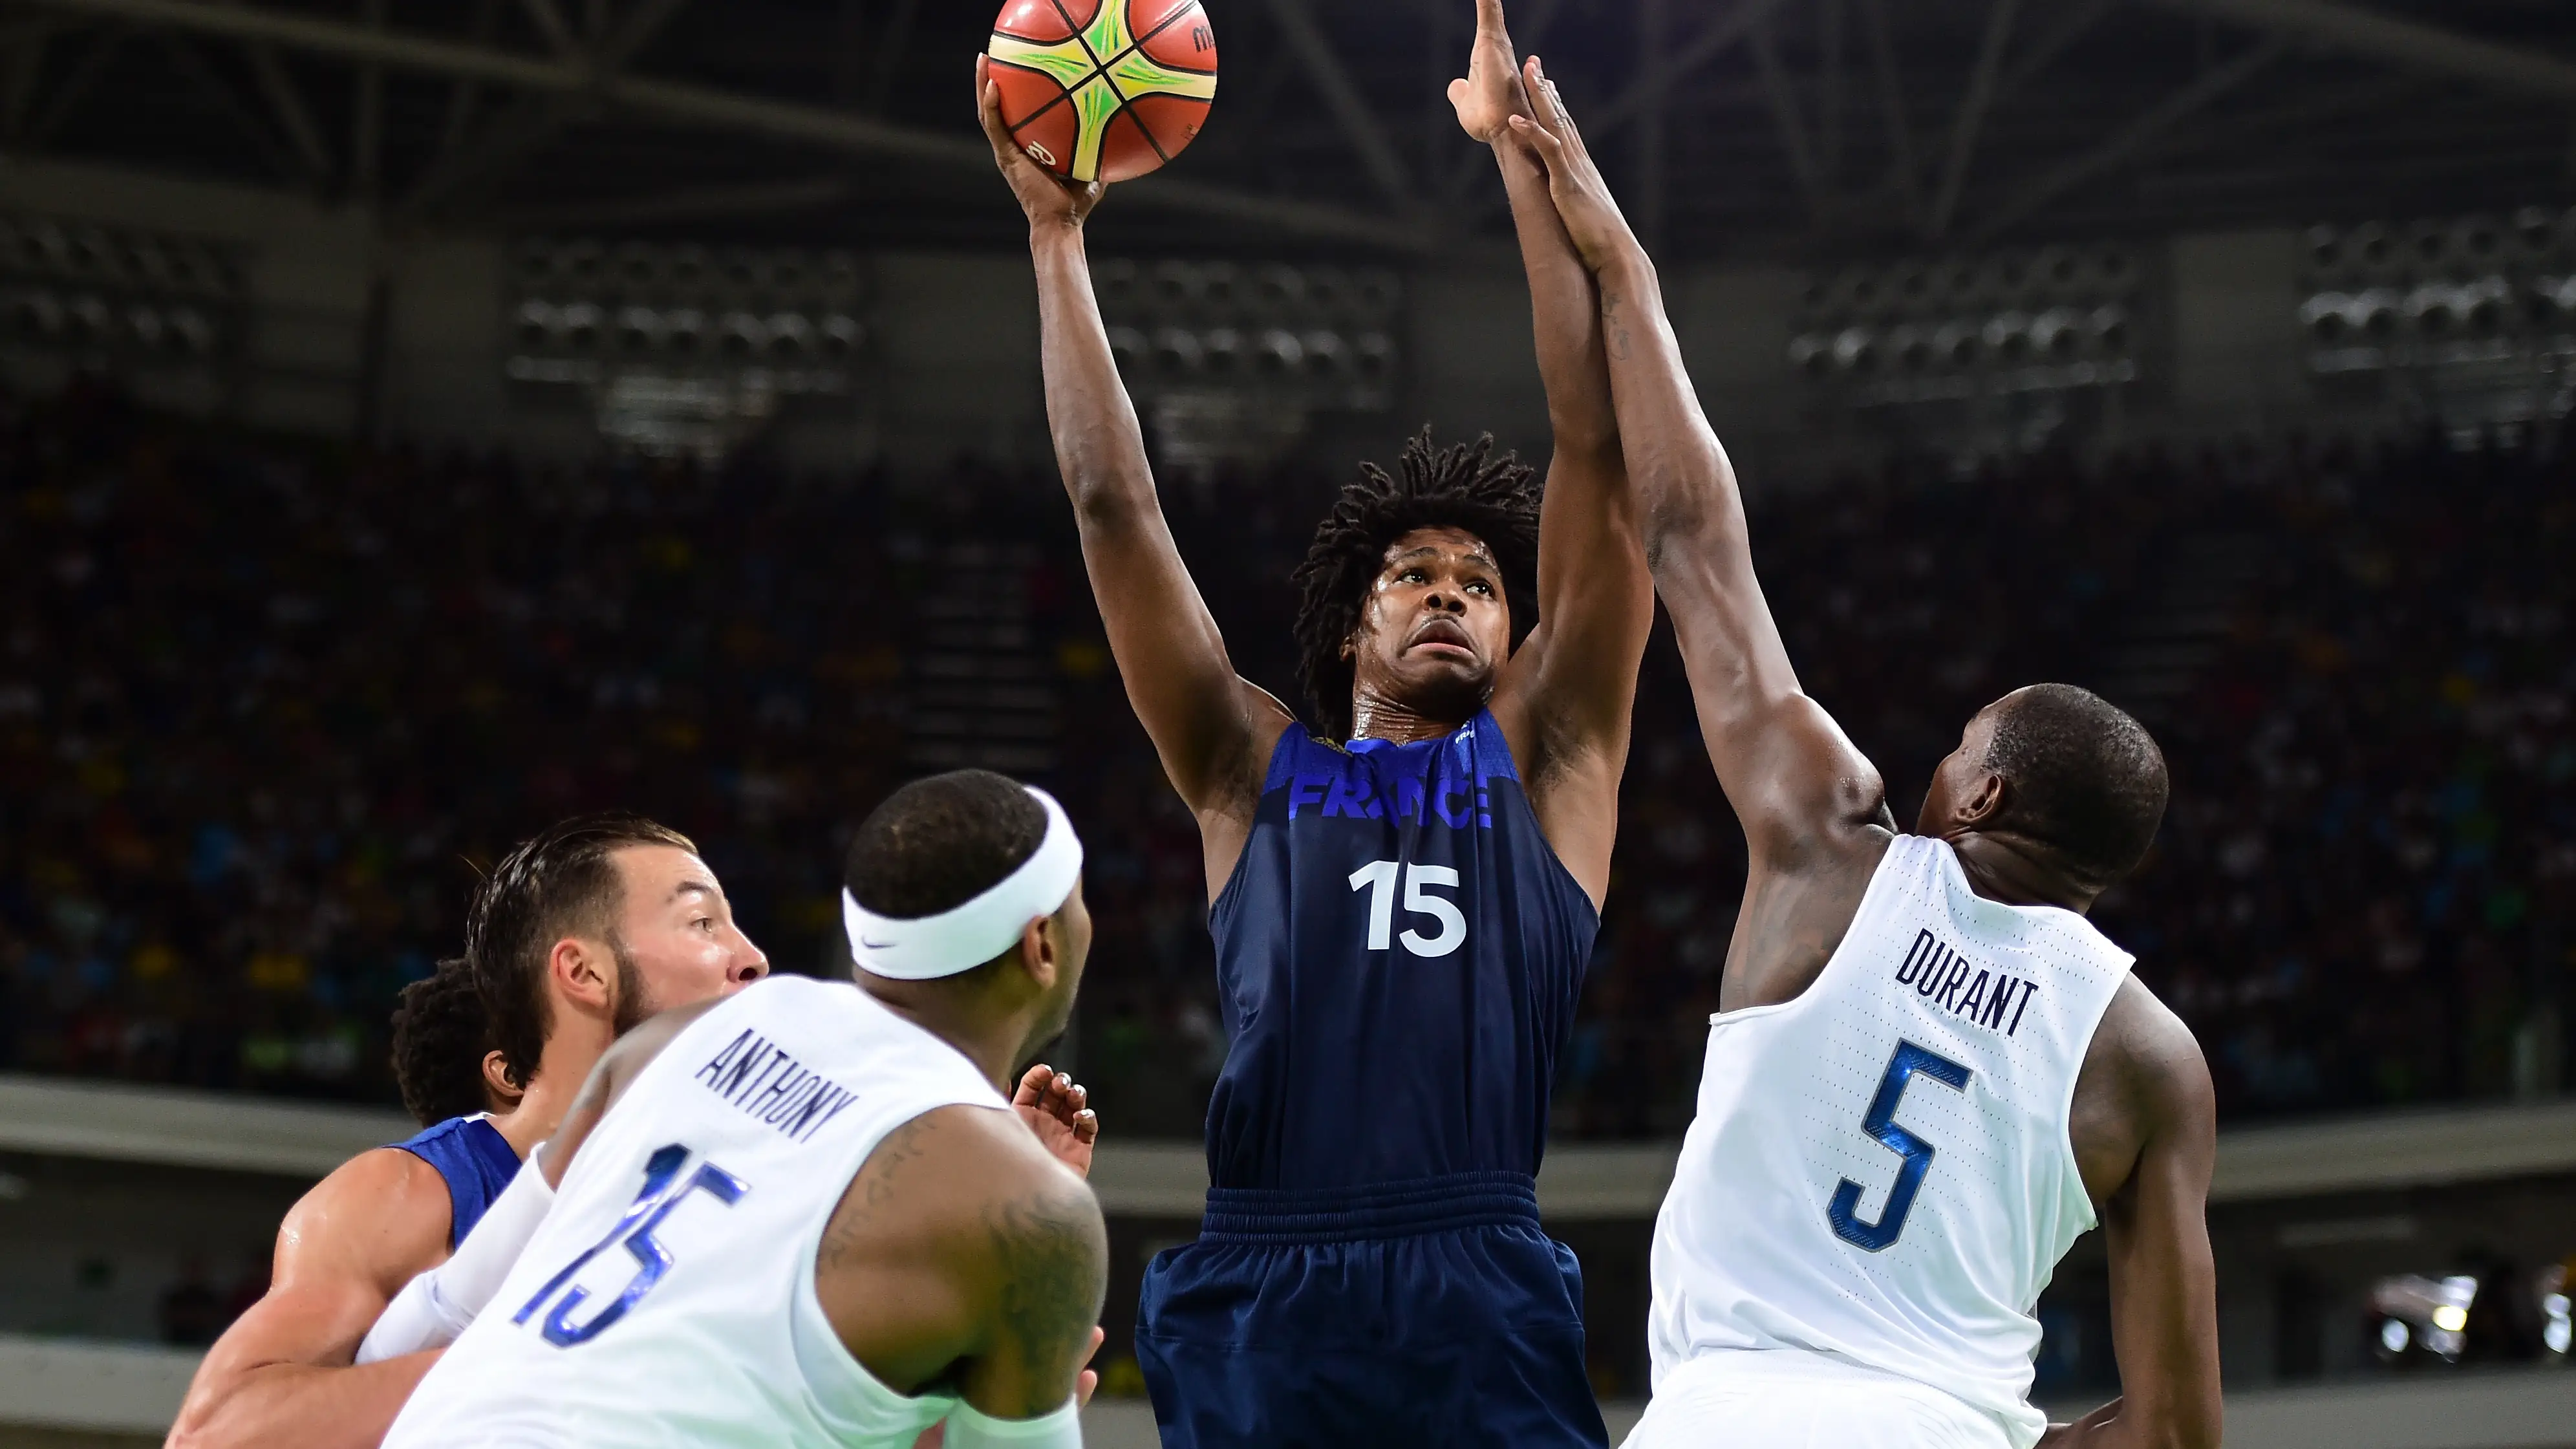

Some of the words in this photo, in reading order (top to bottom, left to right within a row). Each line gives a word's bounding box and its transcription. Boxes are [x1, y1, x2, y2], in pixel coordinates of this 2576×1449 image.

[1348, 860, 1466, 958] 15
[1895, 927, 2039, 1037] DURANT
[695, 1028, 859, 1144] ANTHONY
[1826, 1036, 1973, 1253] 5
[510, 1143, 753, 1348] 15
